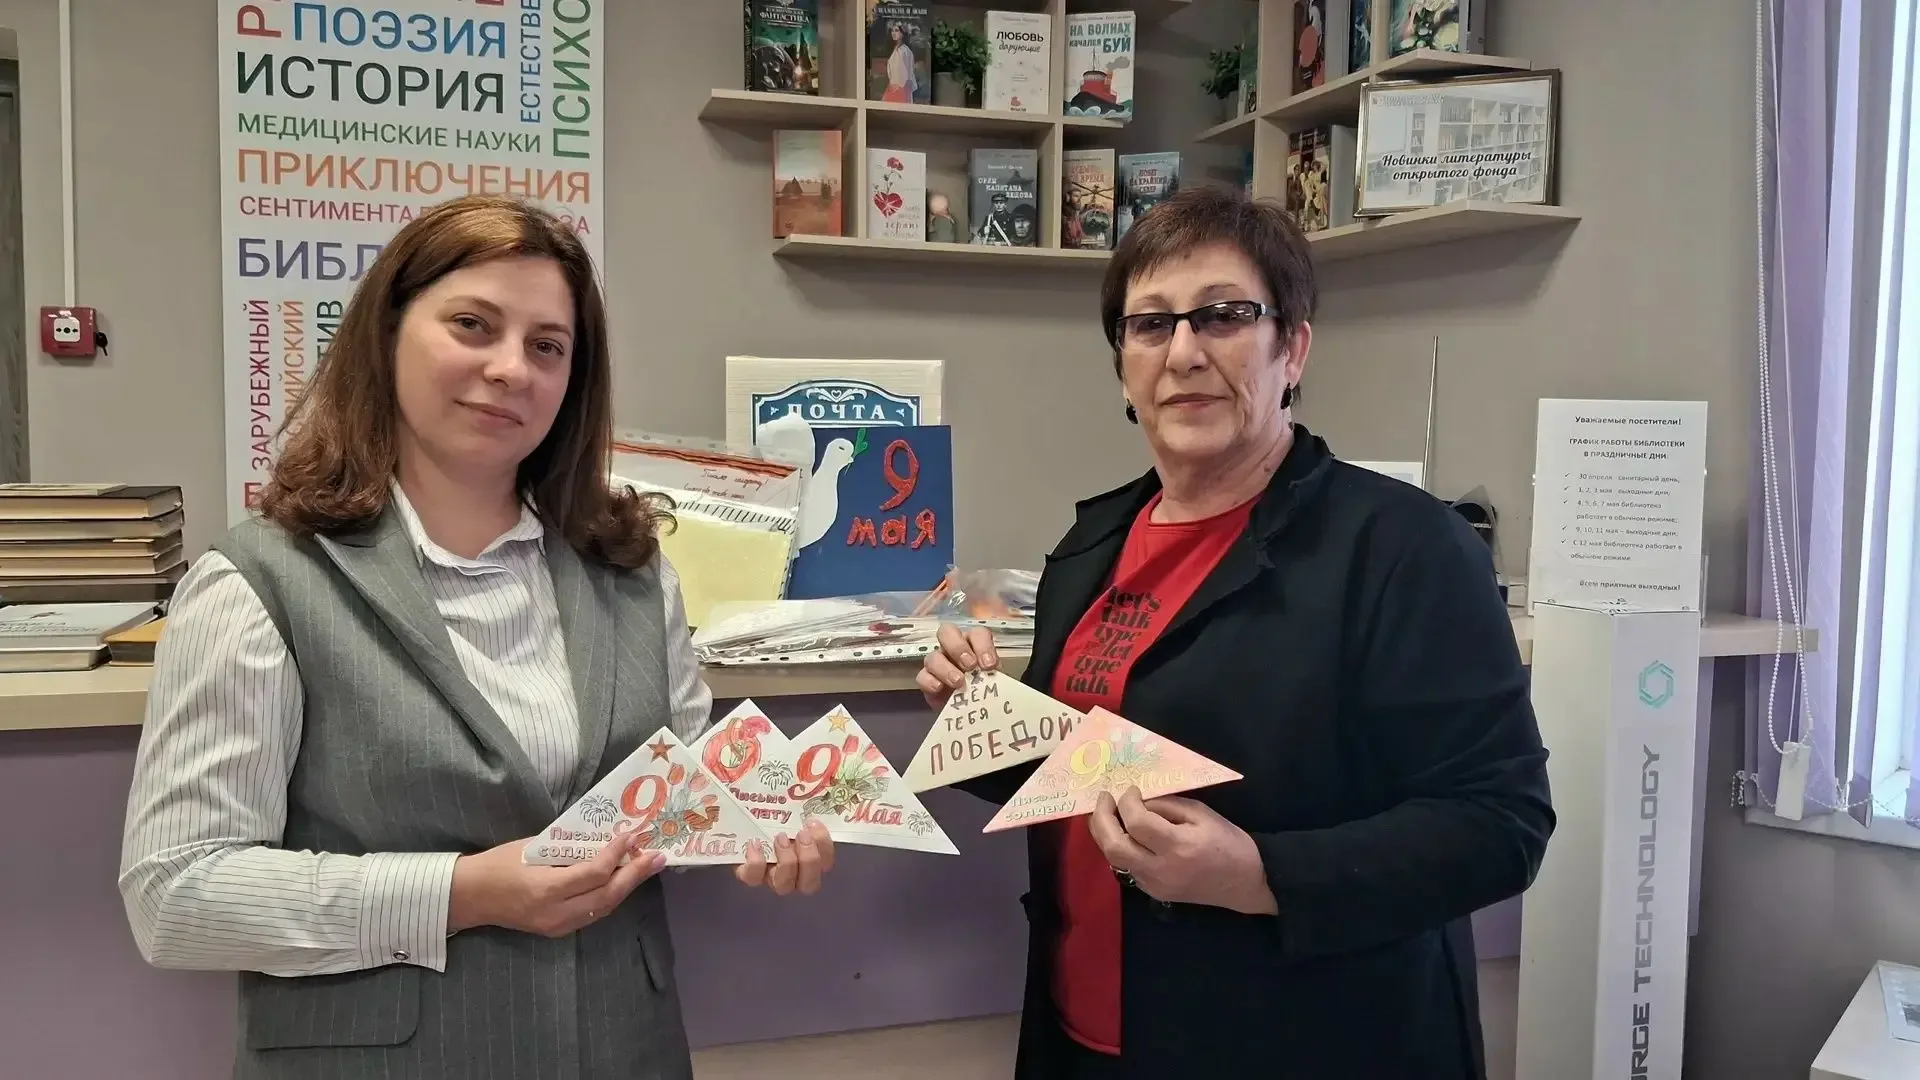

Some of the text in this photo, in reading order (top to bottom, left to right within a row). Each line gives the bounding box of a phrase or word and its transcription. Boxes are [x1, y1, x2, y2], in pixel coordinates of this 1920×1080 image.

[293, 3, 506, 59] ПОЭЗИЯ
[996, 31, 1044, 42] ЛЮБОВЬ
[1070, 22, 1131, 36] НА ВОЛНАХ
[1103, 34, 1132, 53] БУЙ
[236, 51, 504, 114] ИСТОРИЯ
[552, 0, 591, 159] ПСИХО
[238, 112, 541, 154] МЕДИЦИНСКИЕ НАУКИ
[238, 148, 591, 204] ПРИКЛЮЧЕНИЯ
[1382, 151, 1531, 167] Новинки литературы
[1393, 165, 1517, 183] открытого фонда
[239, 196, 432, 223] СЕНТИМЕНТА
[242, 299, 271, 471] ЗАРУБЕЖНЫЙ
[788, 404, 886, 419] ПОЧТА
[1575, 416, 1682, 427] Уважаемые посетители!
[1590, 451, 1647, 459] ПРАЗДНИЧНЫЕ
[879, 439, 919, 512] 9
[847, 508, 936, 549] мая
[944, 708, 989, 732] ТЕБЯ
[786, 743, 842, 801] 9
[1068, 739, 1112, 790] 9
[613, 774, 668, 837] 9
[843, 800, 903, 826] Мая
[550, 826, 613, 842] Письмо
[1631, 744, 1660, 1080] RGE TECHNOLOGY
